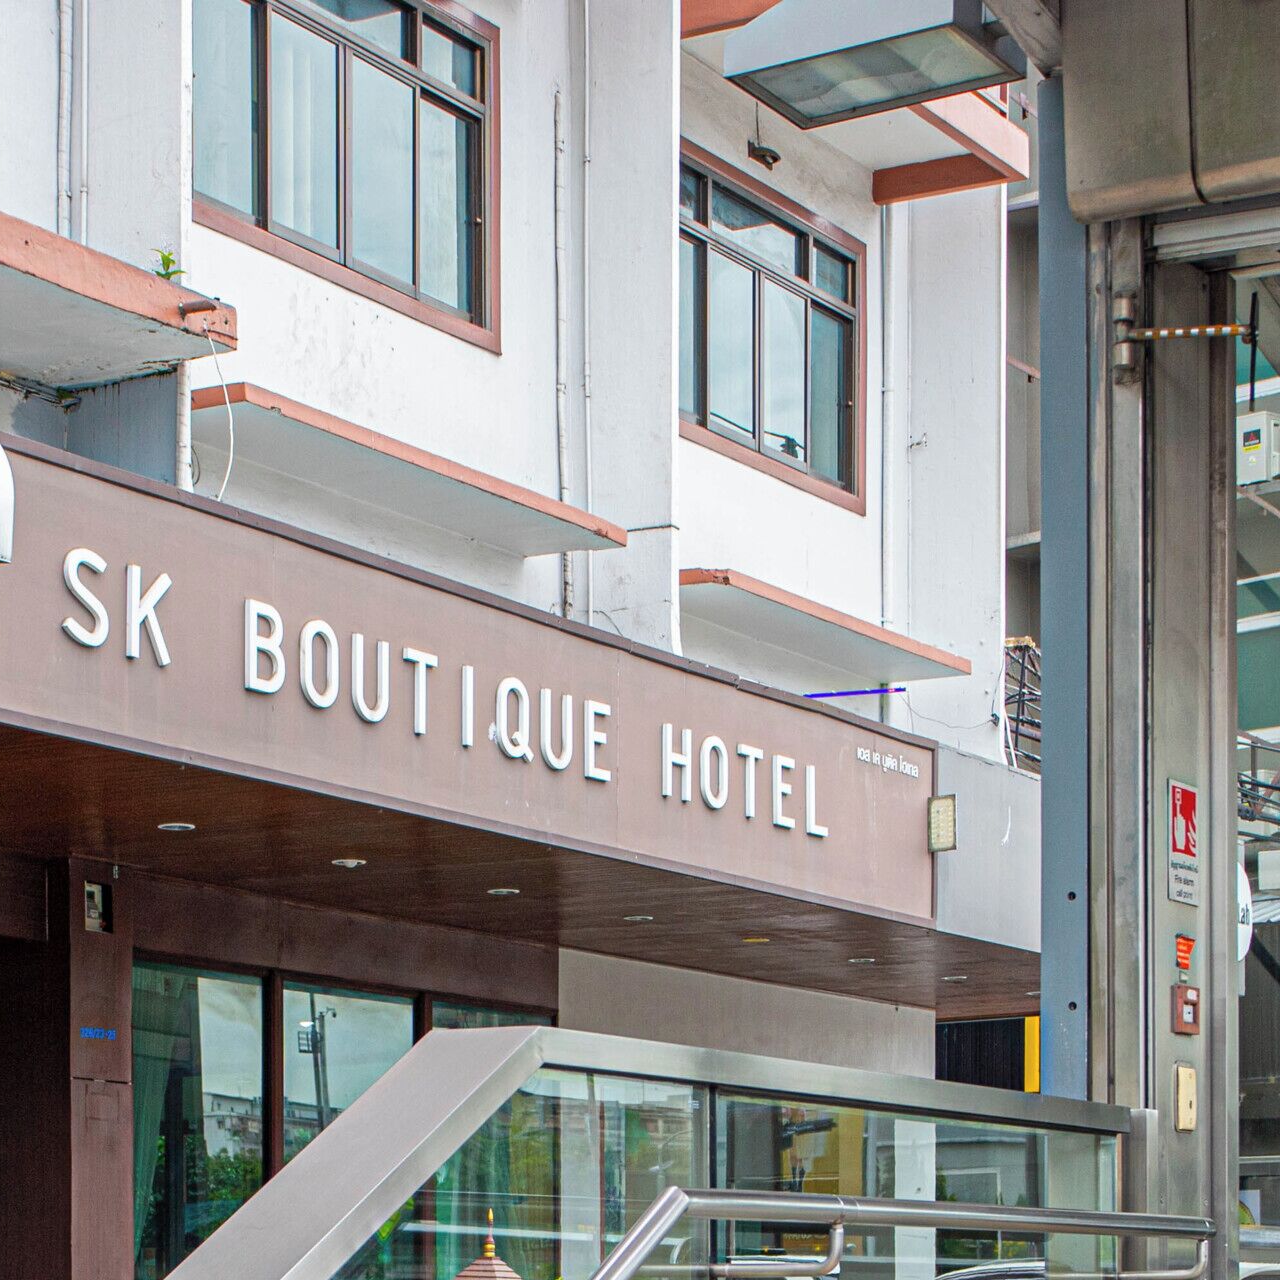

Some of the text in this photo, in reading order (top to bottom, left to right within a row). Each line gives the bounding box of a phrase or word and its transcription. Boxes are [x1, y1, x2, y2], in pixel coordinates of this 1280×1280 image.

[61, 547, 829, 838] SK BOUTIQUE HOTEL
